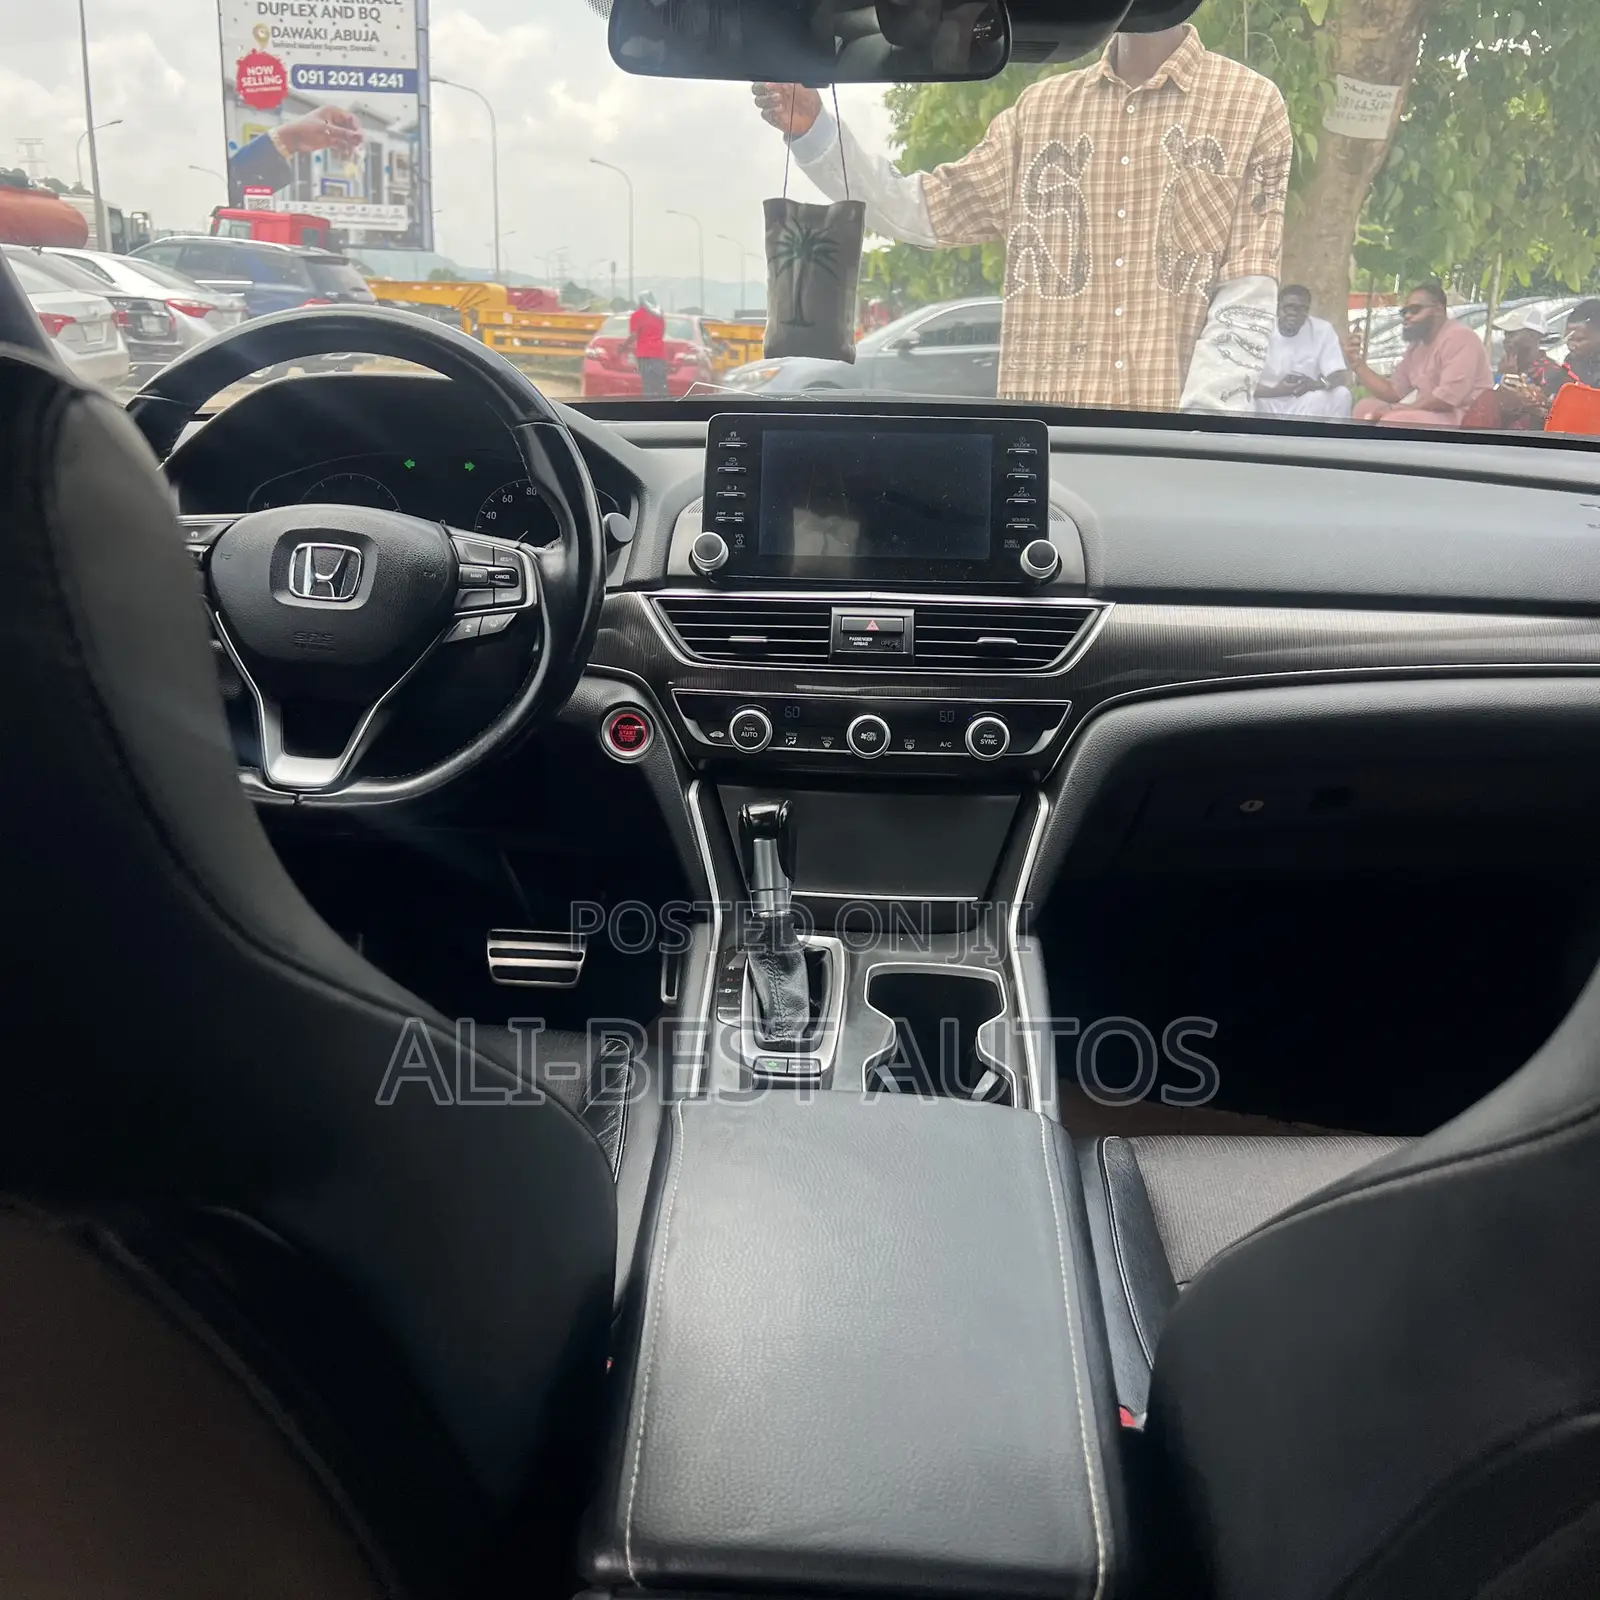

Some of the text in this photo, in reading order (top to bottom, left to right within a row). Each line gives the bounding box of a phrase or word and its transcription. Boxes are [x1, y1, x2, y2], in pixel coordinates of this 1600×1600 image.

[257, 2, 382, 24] DUPLEX AND BQ
[271, 26, 328, 40] DAWAKI
[246, 66, 274, 76] NOW
[241, 75, 283, 87] SELLING
[297, 69, 404, 88] 091 2021 4241
[526, 487, 538, 496] 80
[502, 495, 514, 503] 60
[486, 512, 497, 520] 40
